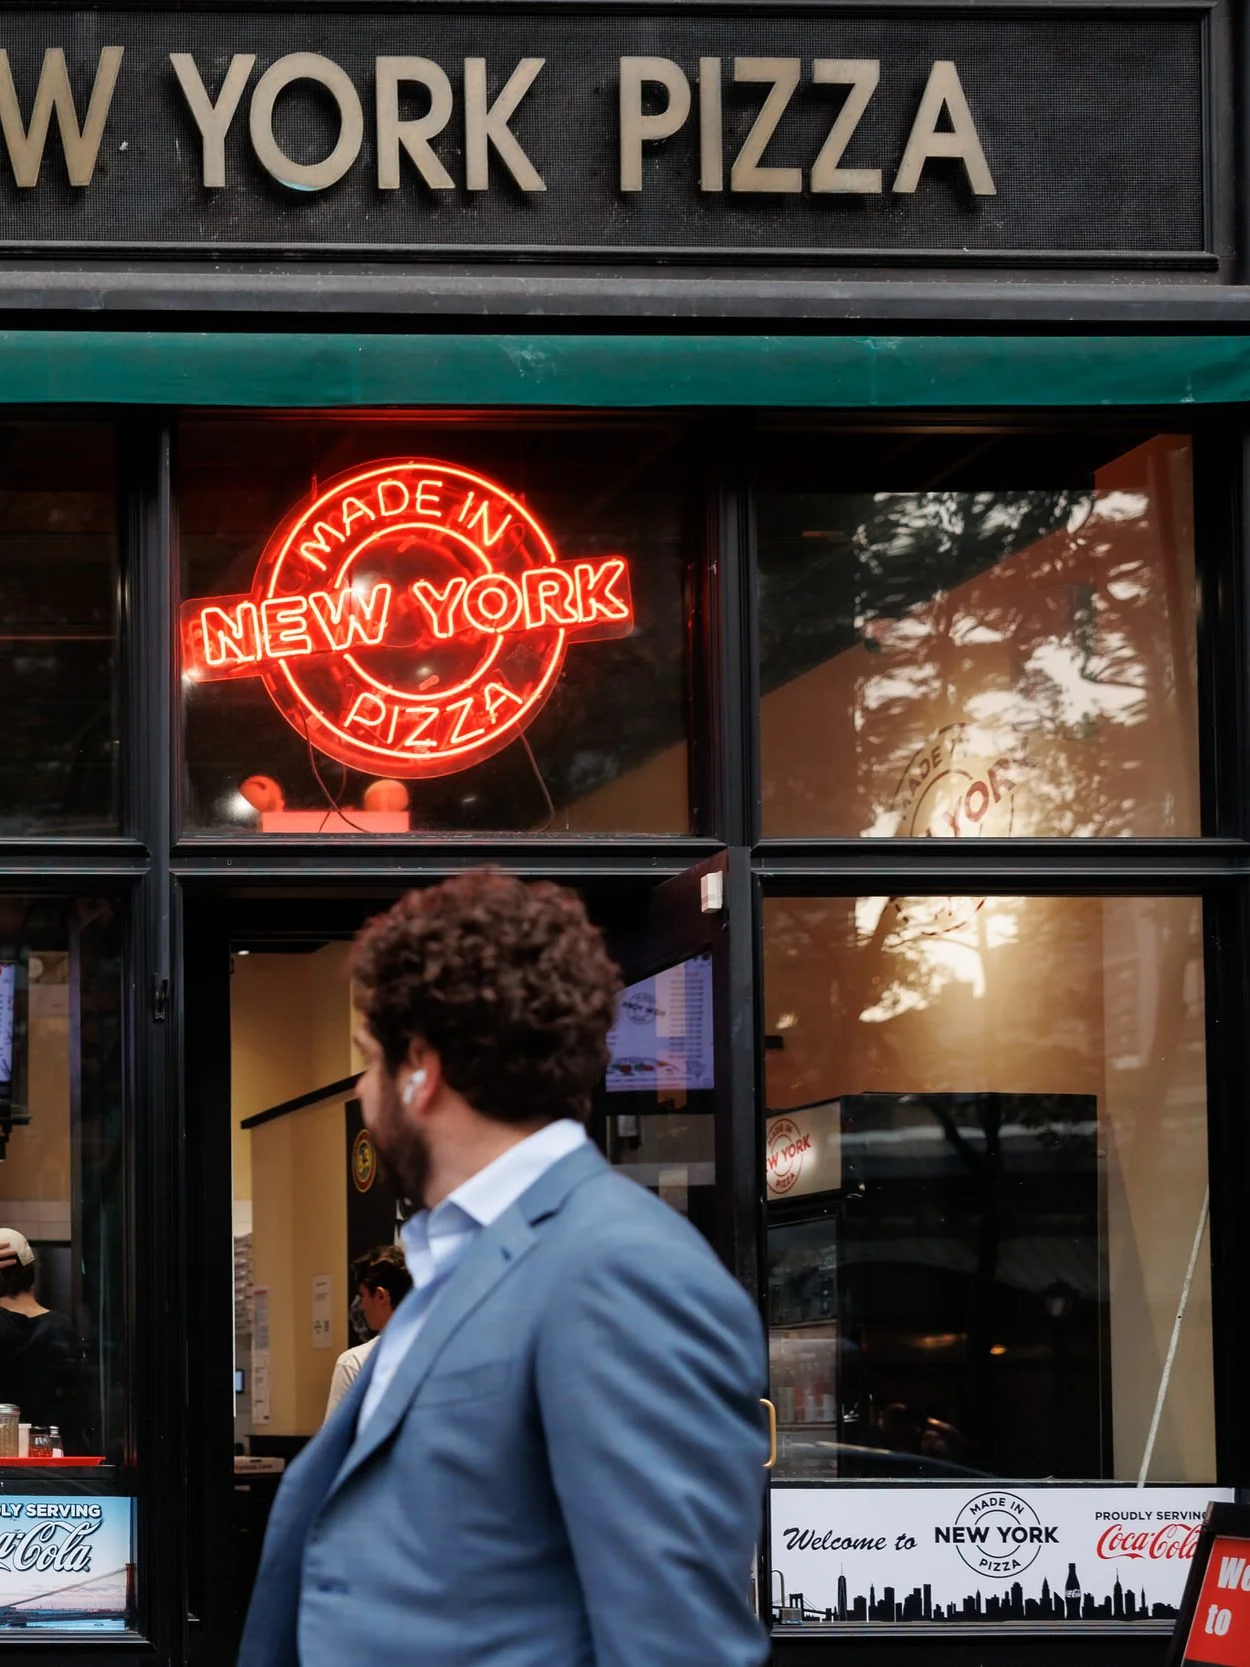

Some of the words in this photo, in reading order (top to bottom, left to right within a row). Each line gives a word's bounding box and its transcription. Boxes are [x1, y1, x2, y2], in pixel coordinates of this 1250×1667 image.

[168, 52, 547, 191] YORK
[619, 56, 996, 195] PIZZA
[300, 479, 443, 571] MADE
[457, 490, 512, 548] IN
[200, 582, 392, 666] NEW
[413, 558, 630, 639] YORK
[344, 681, 523, 748] PIZZA
[782, 1133, 812, 1162] YORK
[25, 1503, 101, 1518] SERVING
[969, 1497, 1007, 1515] MADE
[1010, 1501, 1025, 1515] IN
[1095, 1511, 1153, 1521] PROUDLY
[783, 1527, 888, 1551] Welcome
[894, 1532, 918, 1551] to
[934, 1526, 990, 1544] NEW
[996, 1526, 1060, 1544] YORK
[978, 1557, 1022, 1572] PIZZA
[1204, 1604, 1232, 1636] to
